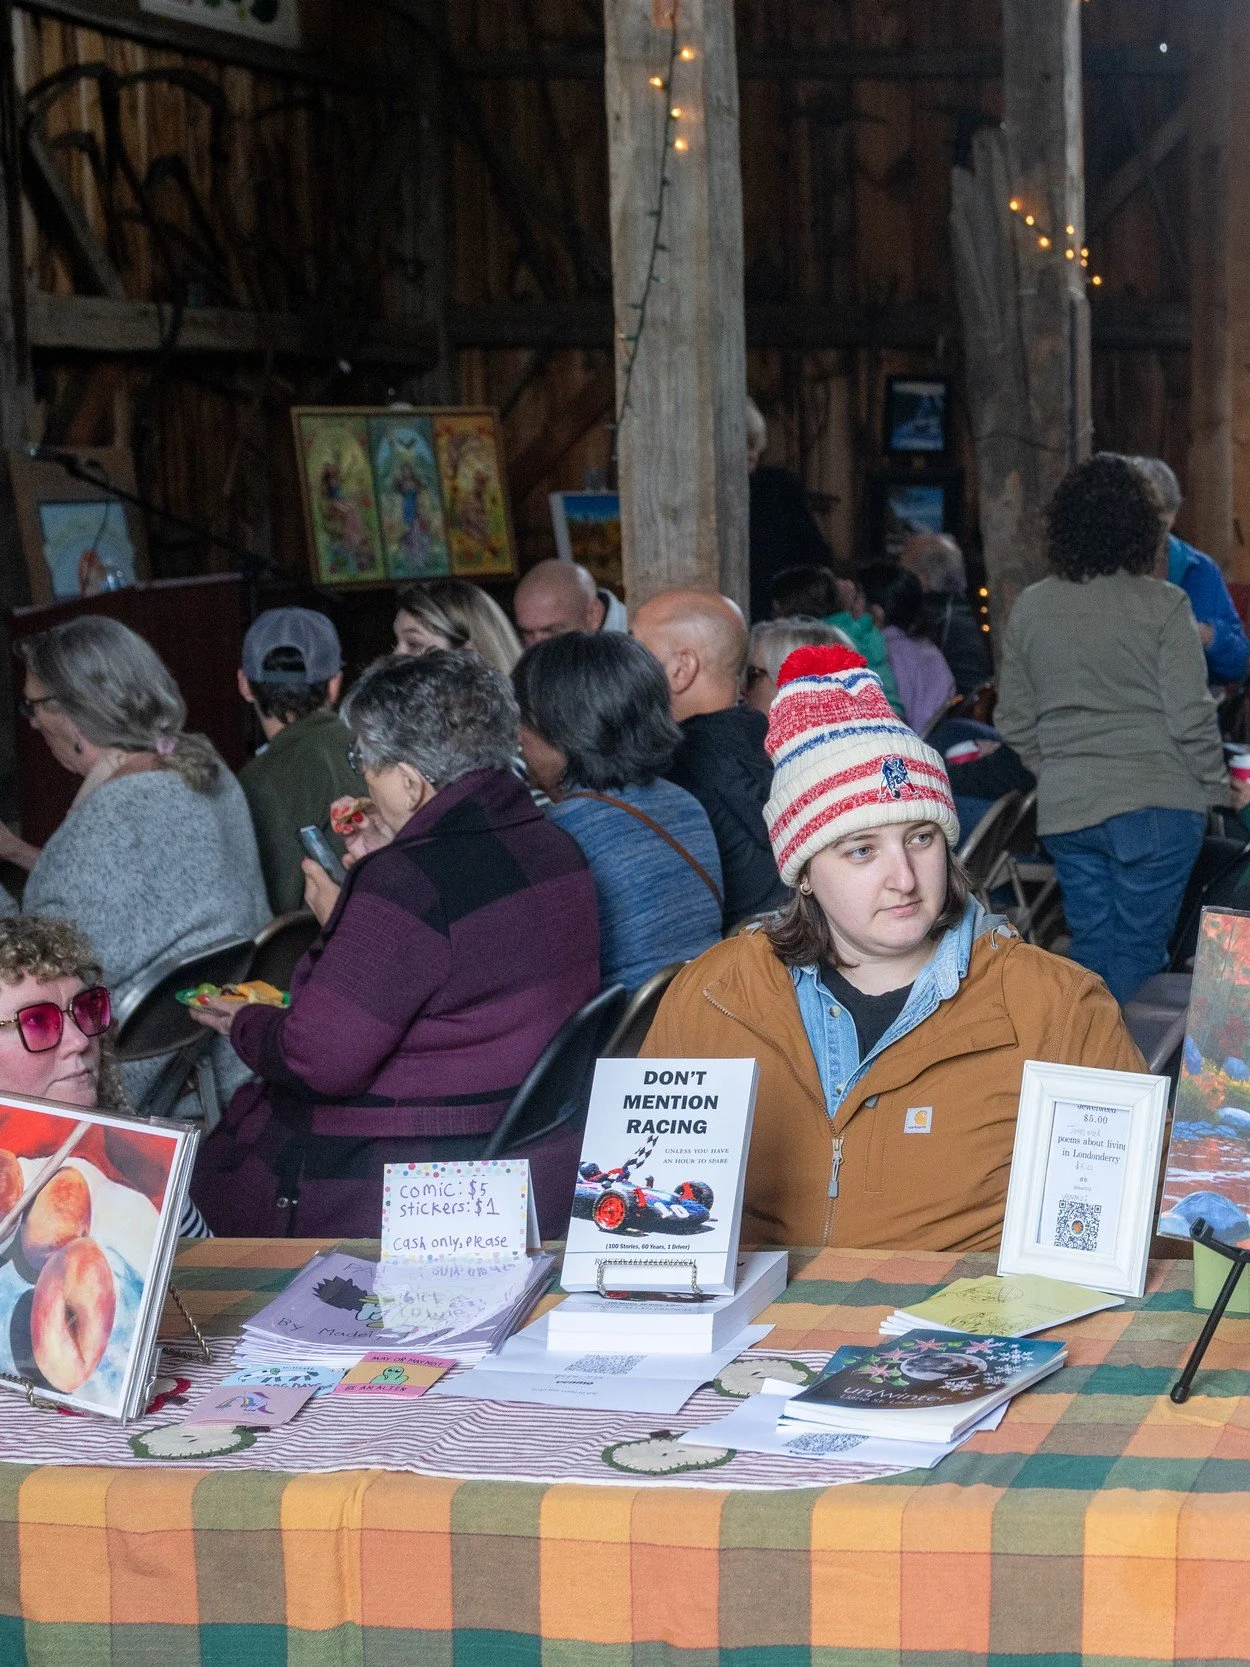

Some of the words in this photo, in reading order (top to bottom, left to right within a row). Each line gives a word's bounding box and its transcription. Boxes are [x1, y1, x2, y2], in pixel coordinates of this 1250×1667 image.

[643, 1070, 707, 1086] DON'T
[623, 1095, 719, 1110] MENTION
[626, 1119, 707, 1134] RACING
[1083, 1114, 1108, 1125] $5.00
[1057, 1135, 1081, 1144] poems
[1083, 1136, 1104, 1147] about
[1062, 1147, 1070, 1157] in
[1073, 1149, 1121, 1164] Londonderry
[400, 1181, 462, 1199] comic:
[468, 1180, 488, 1199] $5
[400, 1201, 470, 1217] stickers:
[474, 1197, 500, 1216] $1
[654, 1202, 690, 1219] 10
[649, 1243, 666, 1251] Years,
[672, 1243, 690, 1251] Driver)
